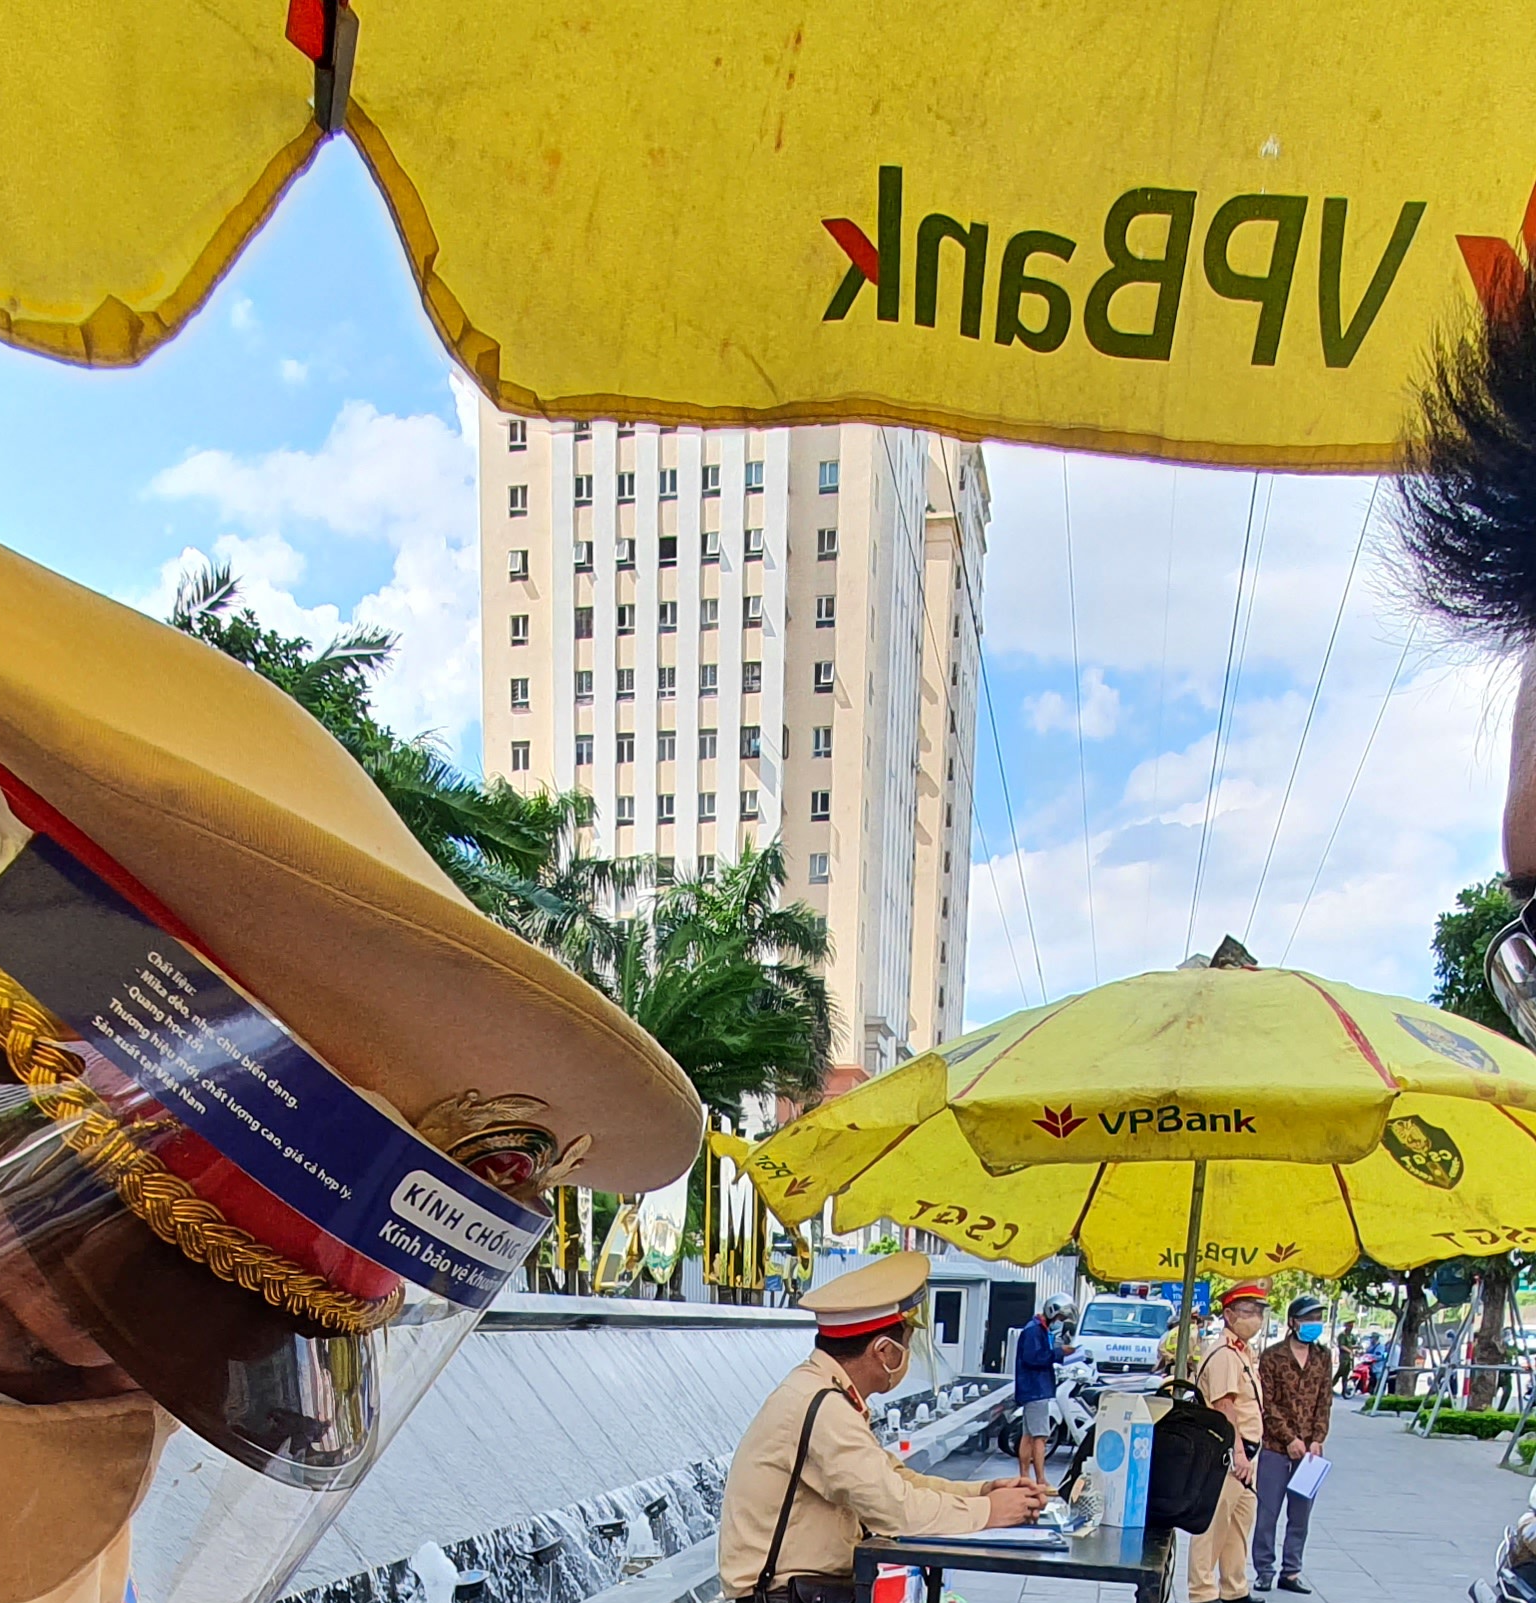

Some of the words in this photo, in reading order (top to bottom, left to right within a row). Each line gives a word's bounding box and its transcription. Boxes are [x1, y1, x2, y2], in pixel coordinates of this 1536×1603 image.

[1097, 1104, 1257, 1135] VPBank
[379, 1221, 421, 1255] Kính
[421, 1245, 452, 1271] bảo
[448, 1263, 467, 1284] vệ
[403, 1182, 463, 1229] KÍNH
[464, 1218, 519, 1260] CHỐNG
